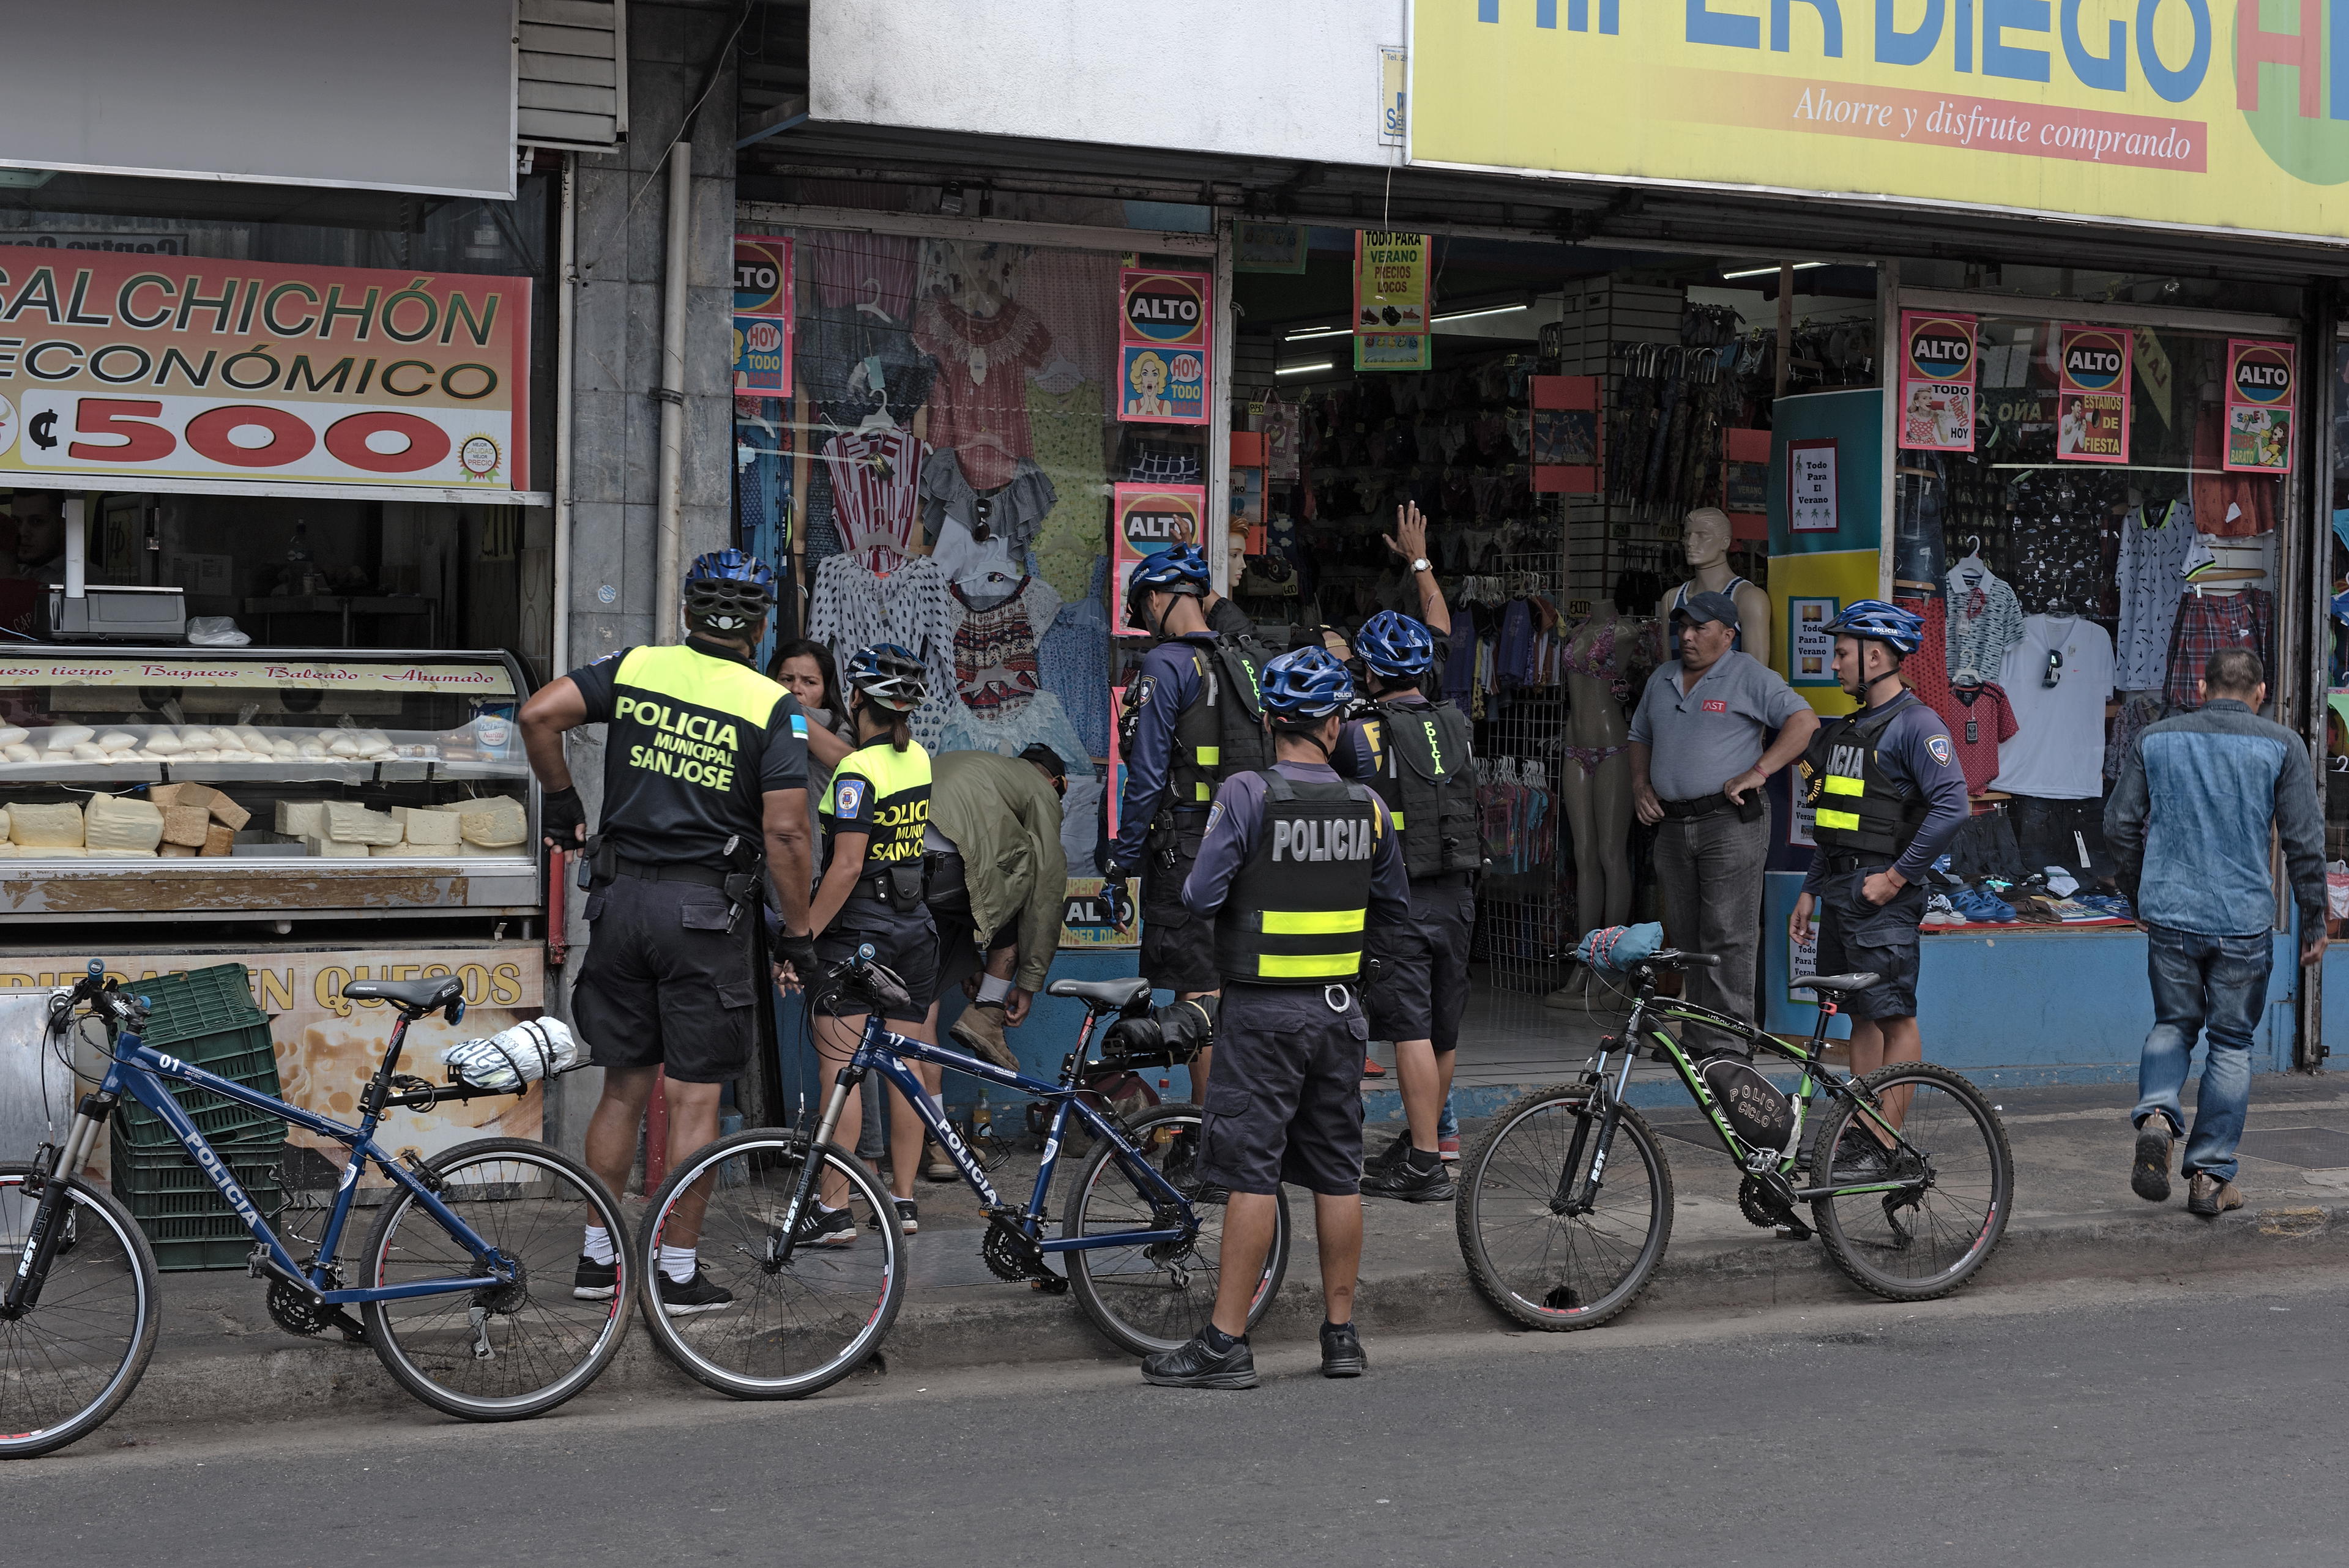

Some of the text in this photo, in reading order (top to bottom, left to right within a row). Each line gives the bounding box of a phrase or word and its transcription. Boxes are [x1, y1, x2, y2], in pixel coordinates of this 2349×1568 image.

[1792, 87, 2192, 160] Ahorre y disfrute comprando
[1365, 231, 1421, 246] TODO PARA
[1370, 250, 1418, 263] VERANO
[1374, 266, 1411, 279] PRECIOS
[1377, 281, 1407, 293] LOCOS
[1131, 297, 1197, 320] ALTO
[749, 327, 777, 347] HOY
[1914, 340, 1968, 359] ALTO
[747, 354, 780, 370] TODO
[1172, 359, 1197, 377] HOY
[2068, 351, 2120, 371] ALTO
[2237, 365, 2288, 385] ALTO
[1171, 385, 1201, 399] TODO
[1932, 385, 1970, 396] TODO
[1948, 395, 1970, 427] BARATO
[2083, 395, 2122, 411] ESTAMOS
[2102, 417, 2119, 429] DE
[1951, 428, 1968, 439] HOY
[2083, 437, 2120, 453] FIESTA
[2230, 450, 2254, 464] BARATO
[1357, 647, 1372, 659] POLICIA
[51, 666, 113, 676] tierno
[141, 665, 238, 678] Bagaces
[264, 666, 358, 680] Baleado
[382, 669, 494, 683] Ahumado
[1703, 702, 1724, 710] AST
[614, 695, 739, 752] POLICIA
[653, 731, 735, 769] MUNICIPAL
[1423, 721, 1446, 775] POLICIA
[1807, 778, 1822, 803] POLICIA
[1272, 818, 1371, 863] POLICIA
[1065, 901, 1134, 922] ALO
[1798, 945, 1815, 954] Todo
[158, 1054, 181, 1072] 01
[994, 1066, 1017, 1076] POLICIA
[283, 1101, 323, 1120] POLICIA
[1729, 1085, 1785, 1129] POLICIA
[1738, 1102, 1770, 1128] CICLO
[939, 1117, 997, 1206] POLICIA
[1590, 1148, 1606, 1183] RST
[184, 1131, 259, 1229] POLICIA
[782, 1196, 798, 1235] RST
[17, 1236, 37, 1277] RST
